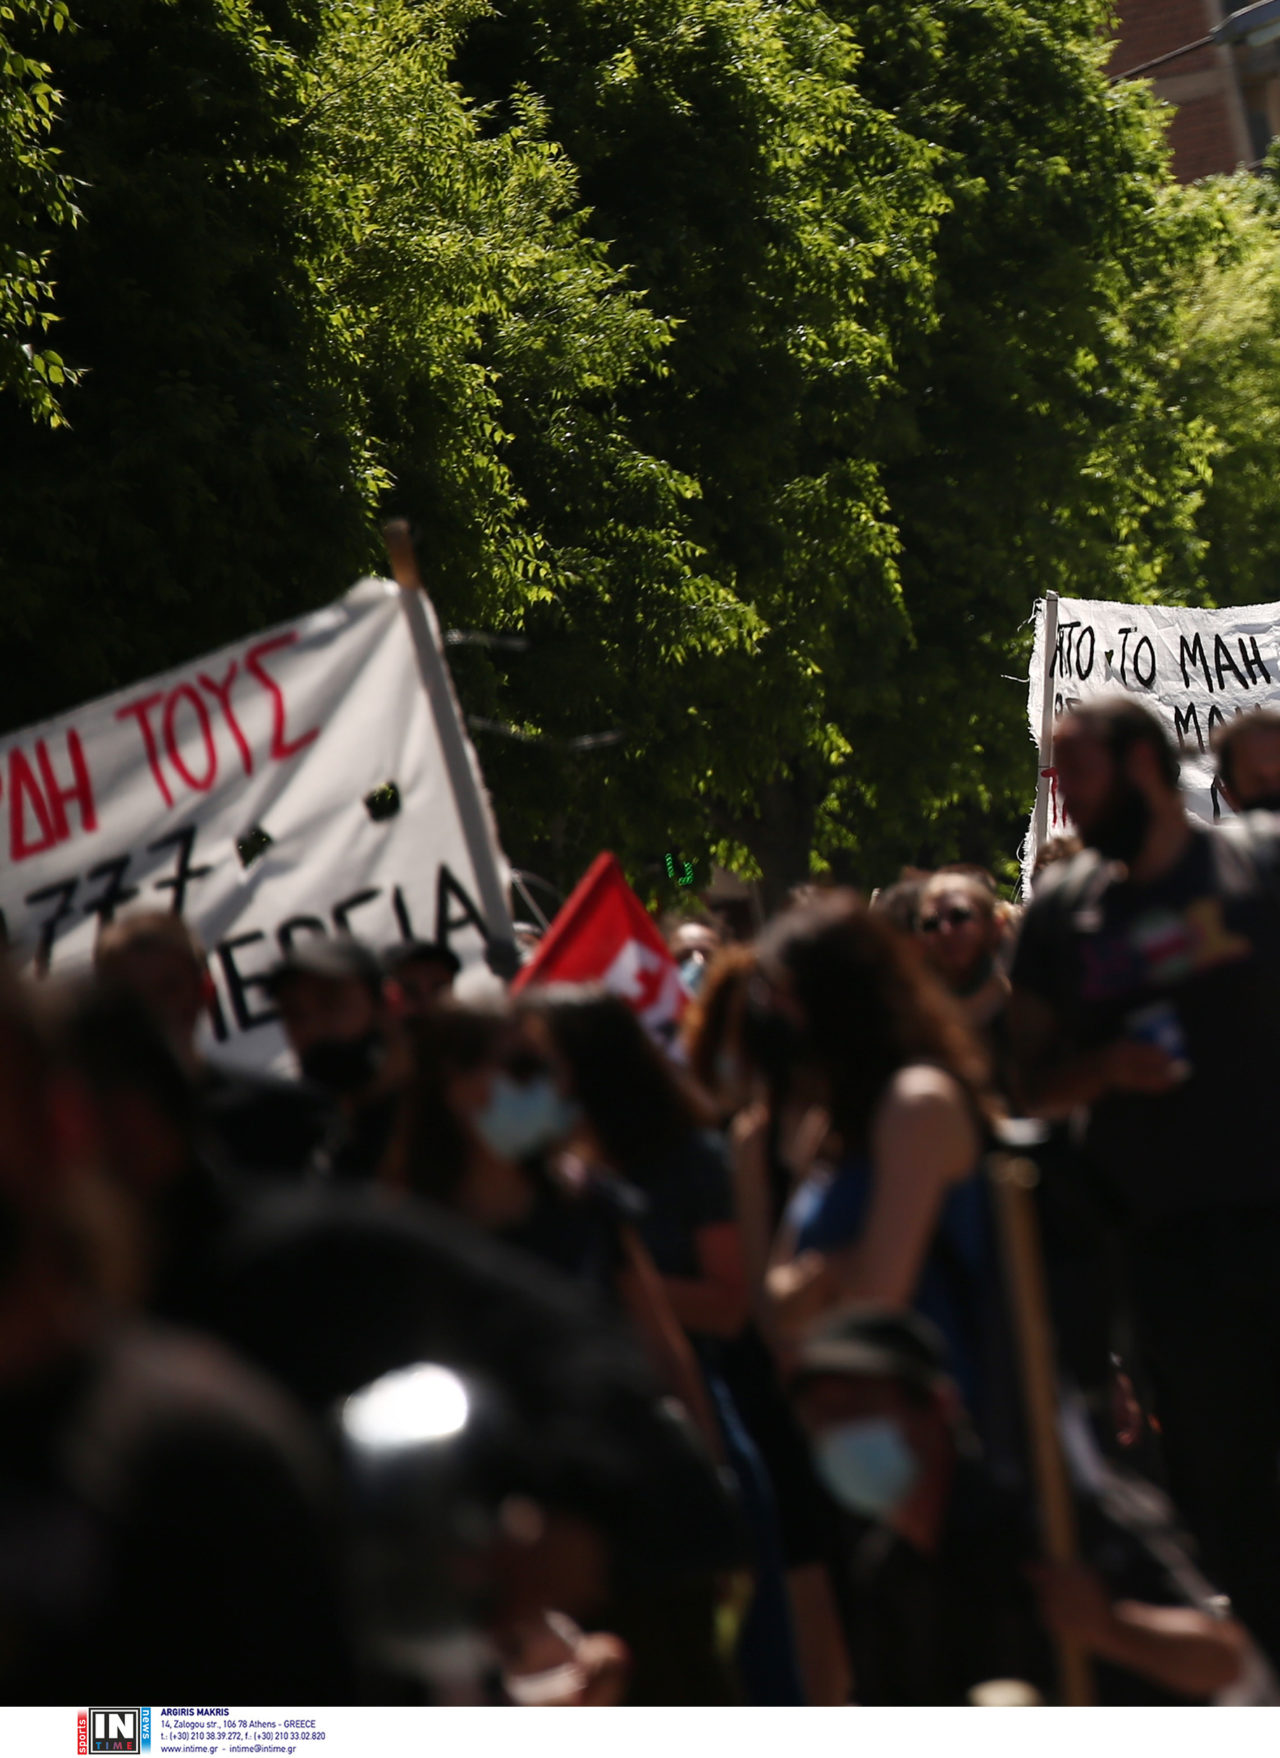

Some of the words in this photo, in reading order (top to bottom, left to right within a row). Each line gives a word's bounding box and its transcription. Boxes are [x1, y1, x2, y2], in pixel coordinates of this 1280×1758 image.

[1117, 627, 1156, 689] ΤΟ
[1180, 632, 1271, 693] ΜΑΗ
[0, 728, 98, 863] ΔΗ
[114, 631, 320, 809] ΤΟΥΣ
[0, 824, 214, 982] 777
